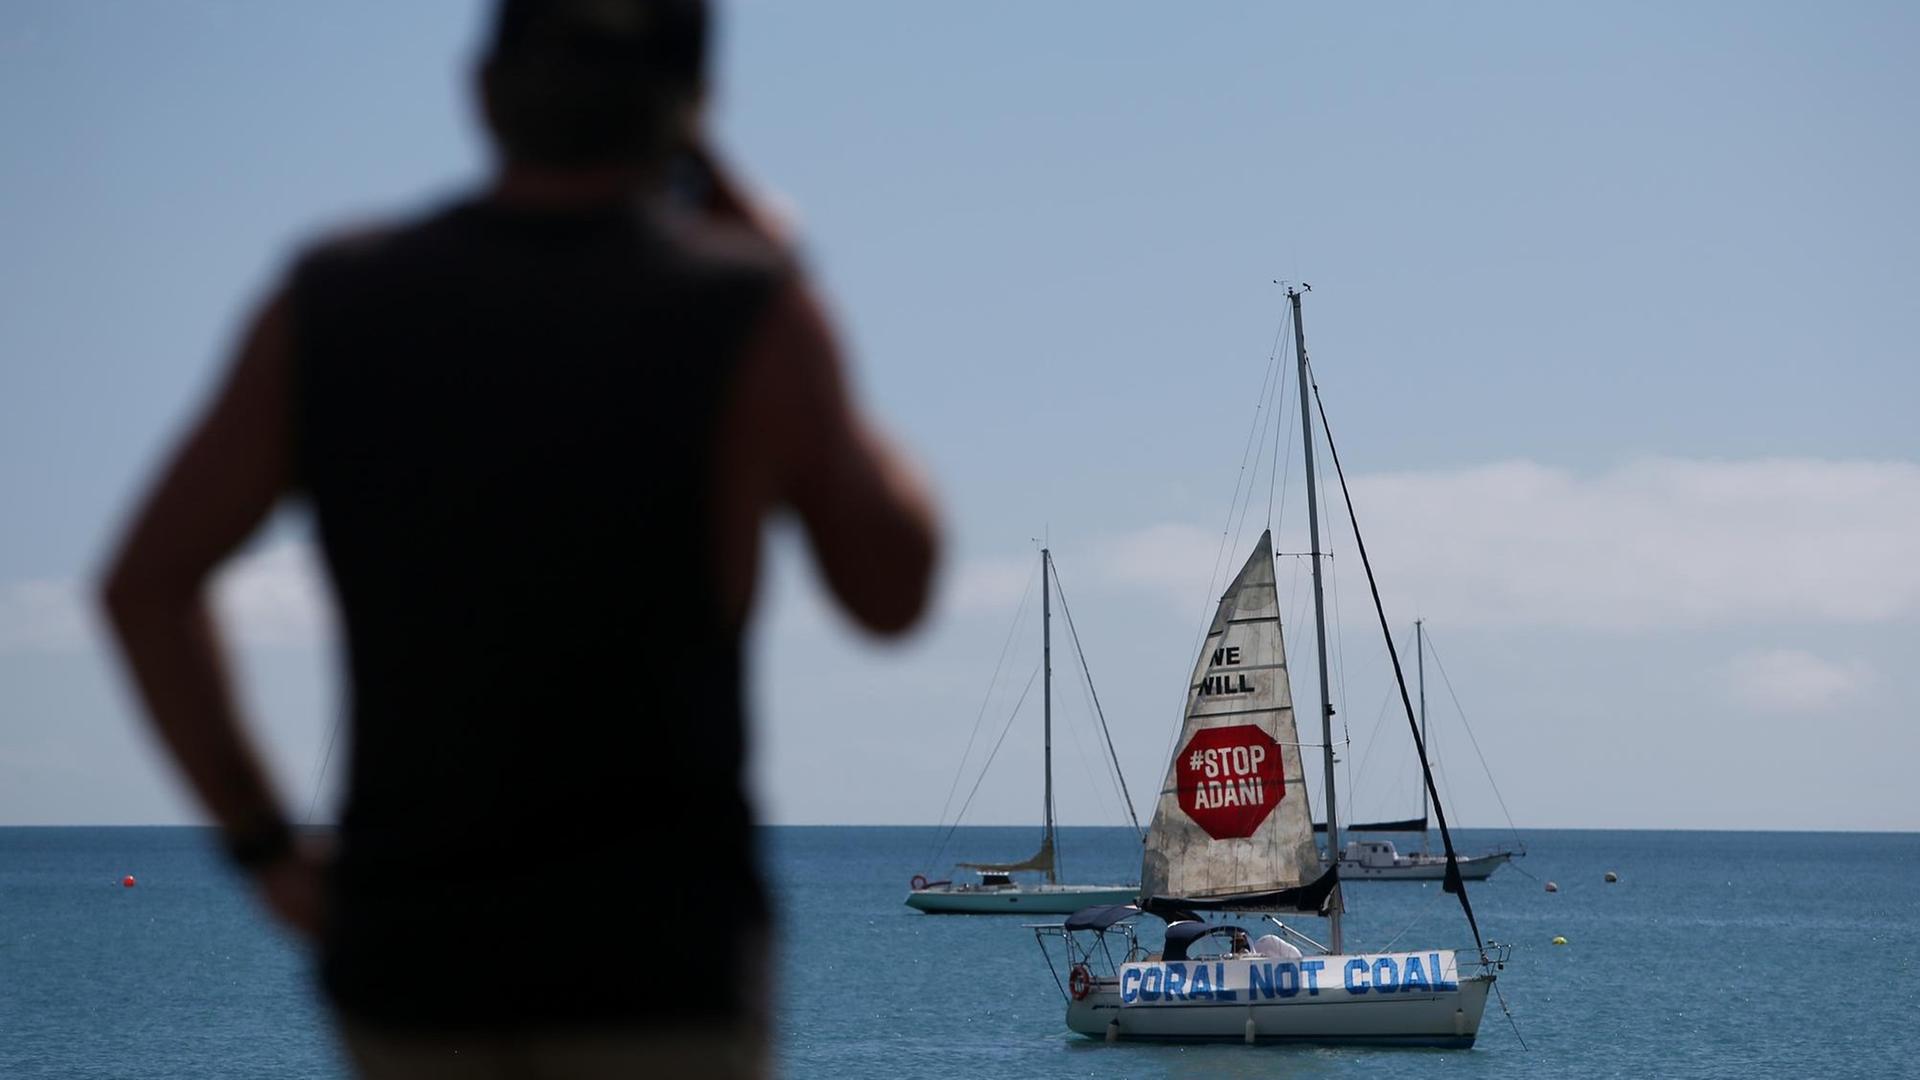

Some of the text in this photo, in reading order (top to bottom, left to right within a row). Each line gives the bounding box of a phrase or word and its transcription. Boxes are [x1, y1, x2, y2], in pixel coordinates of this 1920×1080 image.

[1190, 745, 1265, 777] #STOP
[1195, 777, 1264, 809] ADANI
[1122, 953, 1458, 1004] CORAL NOT COAL
